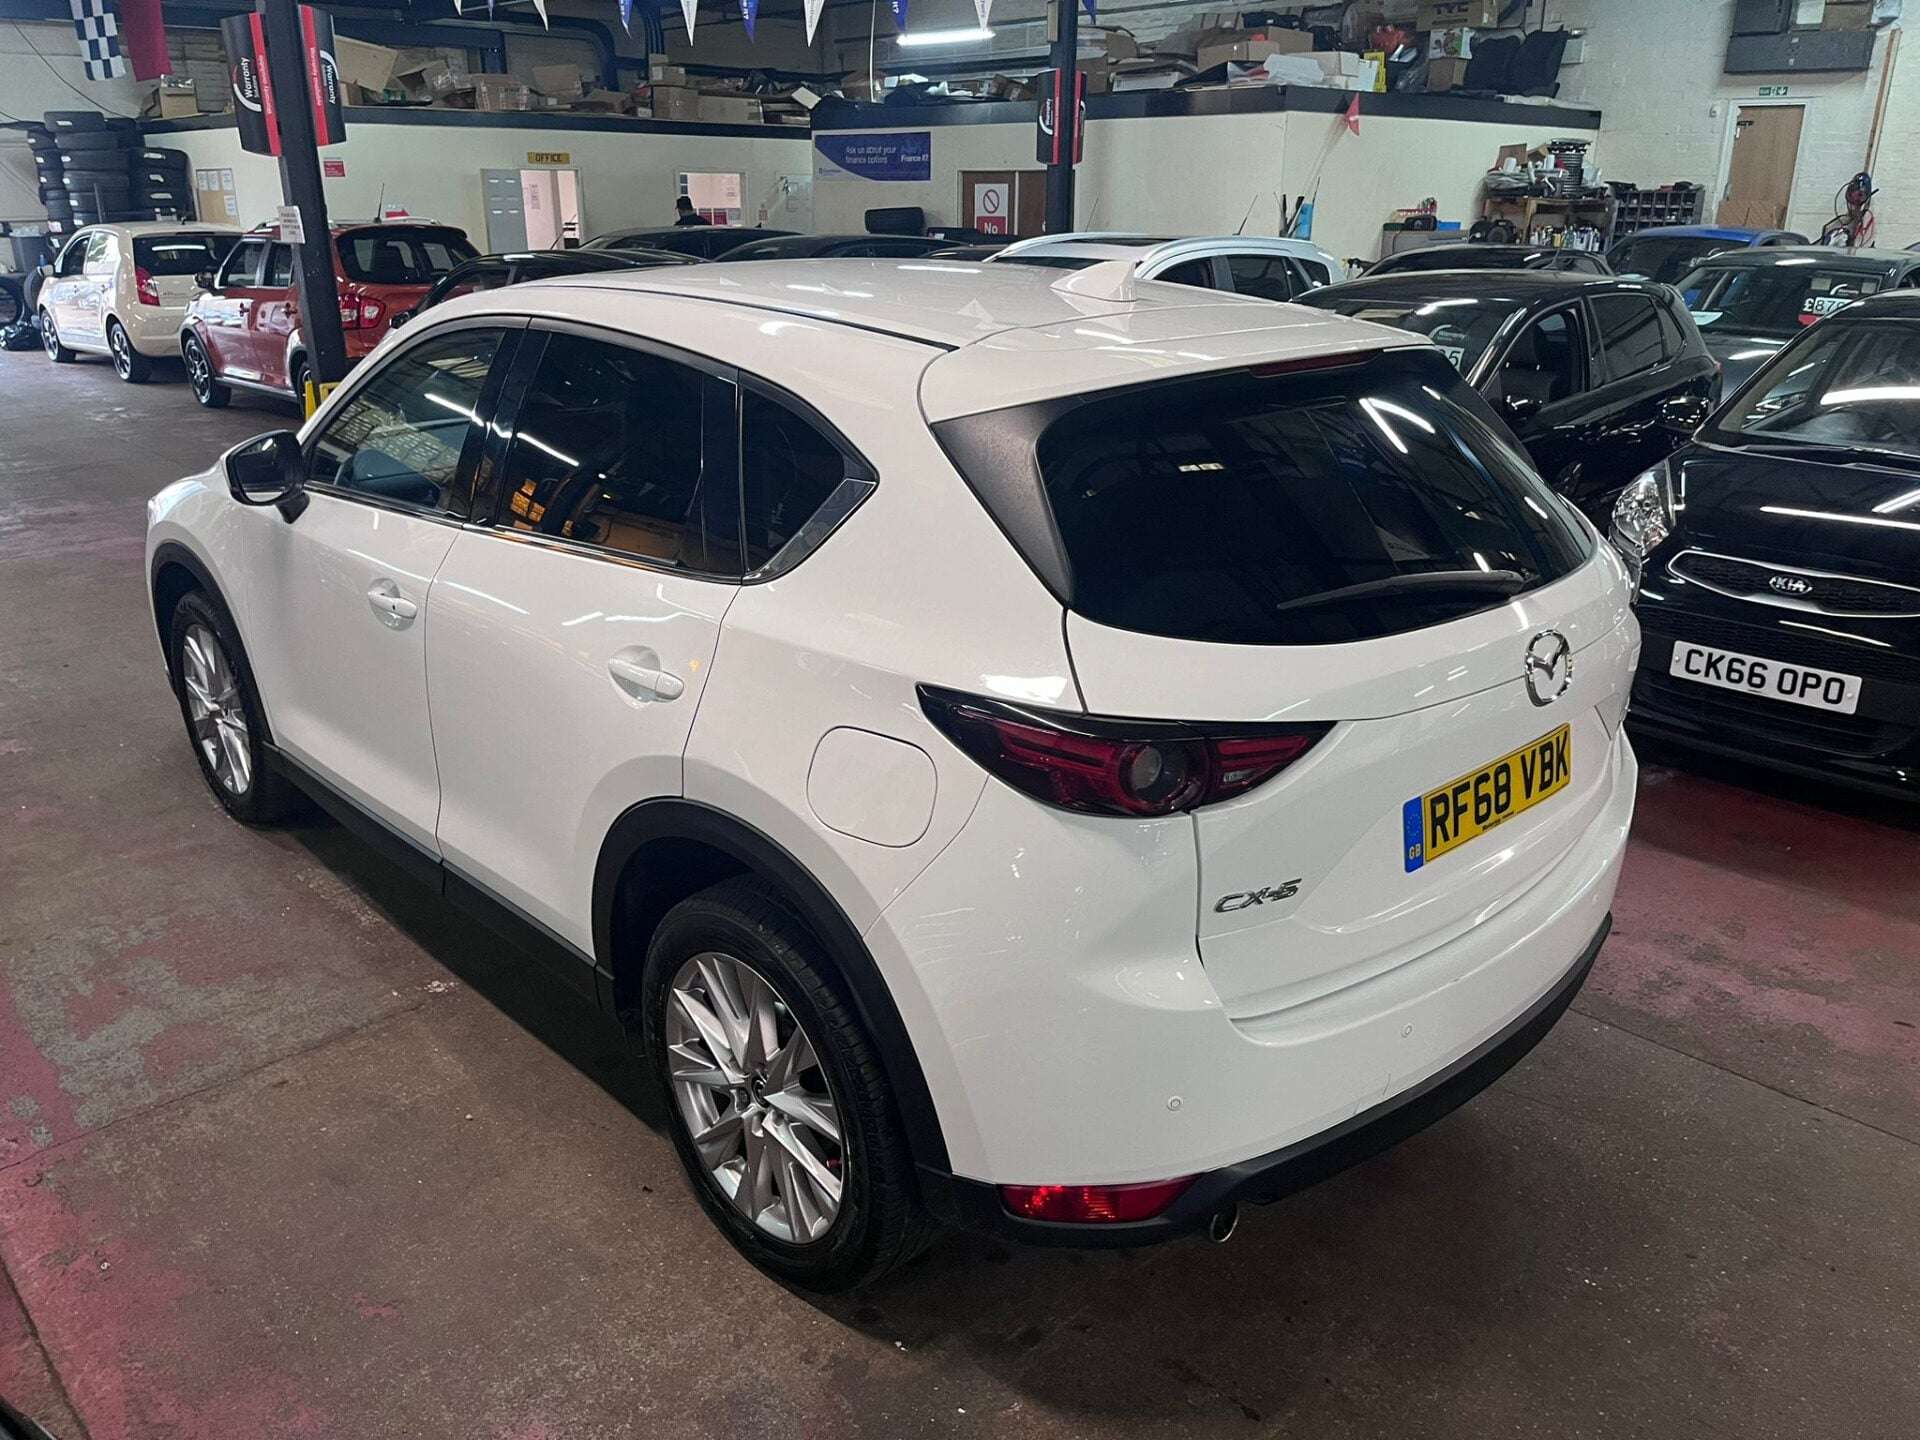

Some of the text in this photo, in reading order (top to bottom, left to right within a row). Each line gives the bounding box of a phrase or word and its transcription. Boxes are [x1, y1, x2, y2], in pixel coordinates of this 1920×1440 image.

[240, 57, 253, 98] Warranty
[325, 64, 336, 104] Warranty
[535, 153, 563, 162] OFFICE
[984, 222, 999, 234] No
[1776, 577, 1806, 592] KIA
[1684, 649, 1846, 705] CK66 OPO
[1430, 731, 1568, 849] RF68 VBK
[1408, 843, 1422, 860] GB
[1214, 878, 1303, 914] CX-5
